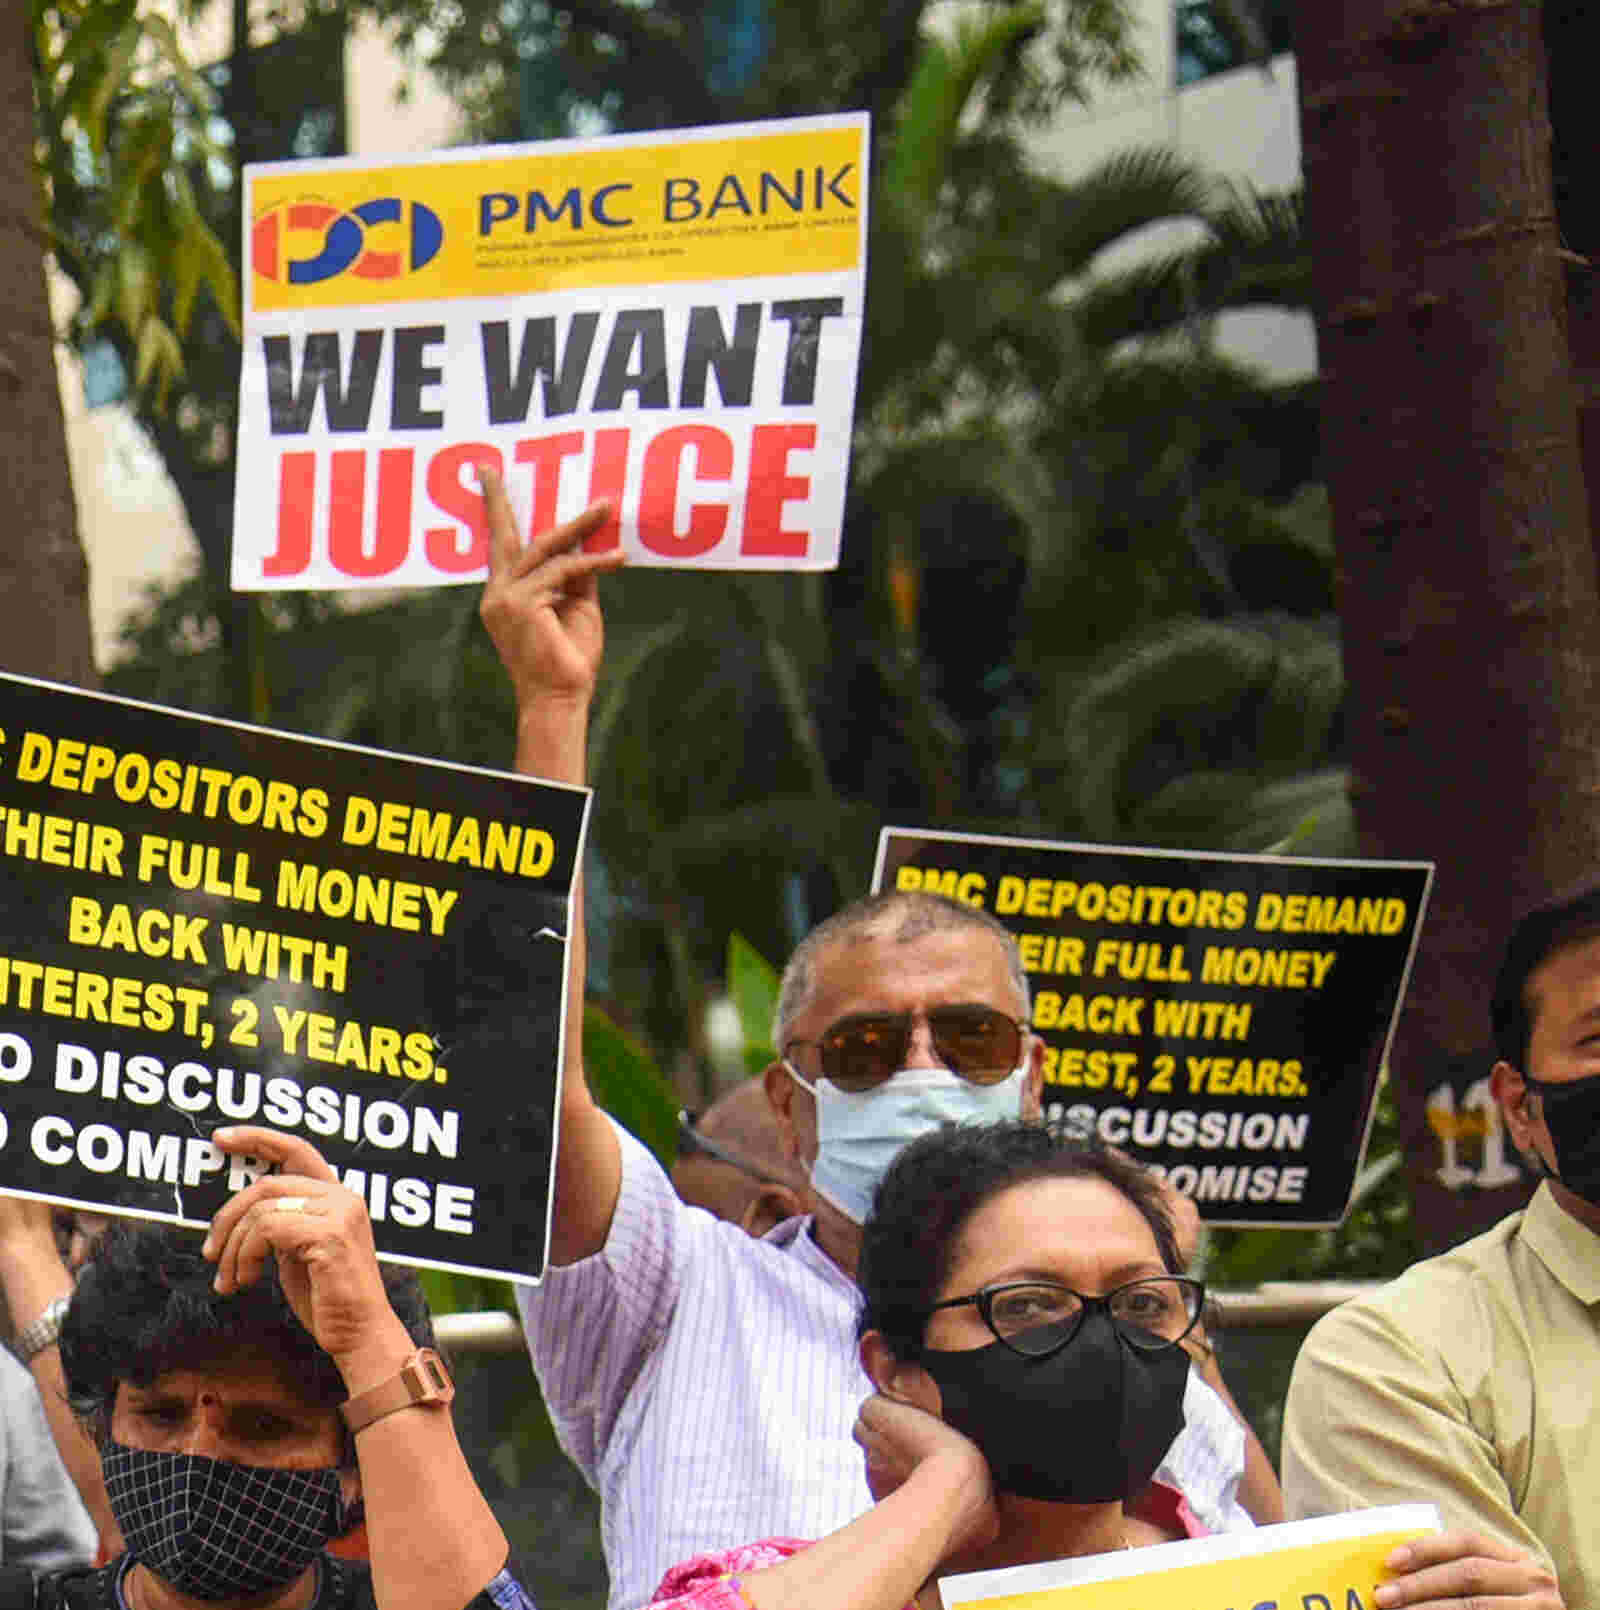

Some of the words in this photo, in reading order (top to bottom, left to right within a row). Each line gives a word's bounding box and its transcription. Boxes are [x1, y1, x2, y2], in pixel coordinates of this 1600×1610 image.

[479, 183, 634, 237] PMC
[664, 163, 856, 224] BANK
[262, 324, 445, 436] WE
[480, 297, 844, 425] WANT
[262, 423, 818, 577] JUSTICE
[15, 733, 329, 838] DEPOSITORS
[342, 797, 555, 879] DEMAND
[138, 834, 261, 902] FULL
[275, 860, 459, 936] MONEY
[995, 875, 1248, 930] DEPOSITORS
[1254, 892, 1407, 935] DEMAND
[69, 897, 206, 967] BACK
[223, 923, 349, 993] WITH
[1094, 940, 1192, 983] FULL
[1202, 946, 1337, 989] MONEY
[230, 998, 260, 1047] 2
[271, 1005, 448, 1084] YEARS.
[1032, 992, 1146, 1037] BACK
[1153, 1001, 1253, 1041] WITH
[53, 1046, 460, 1159] DISCUSSION
[1147, 1054, 1176, 1094] 2
[1185, 1057, 1309, 1097] YEARS.
[30, 1119, 476, 1235] COMPRMISE
